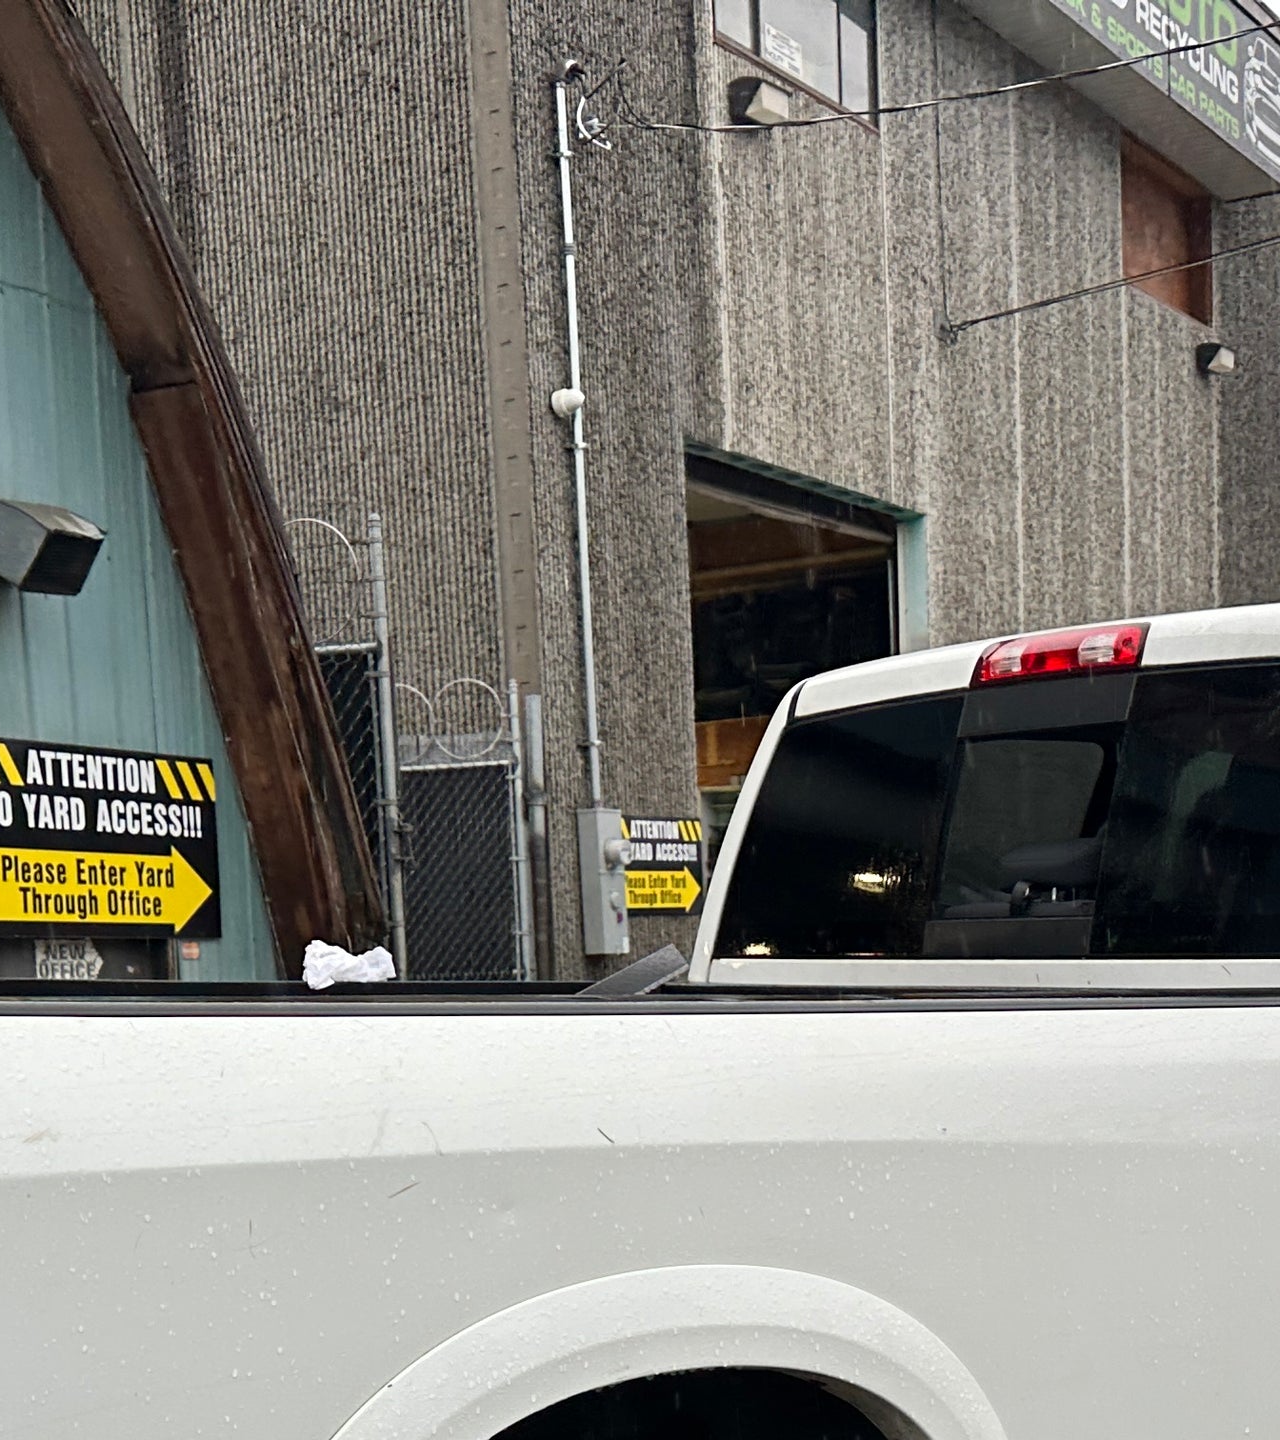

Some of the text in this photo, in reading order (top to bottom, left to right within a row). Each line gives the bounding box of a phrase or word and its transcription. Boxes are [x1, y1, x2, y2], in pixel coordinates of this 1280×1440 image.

[1136, 0, 1238, 104] RECYCLING
[1200, 91, 1240, 140] PARTS
[26, 749, 156, 795] ATTENTION
[21, 792, 87, 832] YARD
[96, 799, 203, 839] ACCESS!!!
[630, 820, 679, 839] ATTENTION
[1, 855, 174, 888] Please Enter Yard
[648, 874, 668, 889] Enter
[670, 874, 687, 889] Yard
[19, 887, 162, 919] Through Office
[629, 890, 682, 906] Through Office
[45, 943, 86, 960] NEW
[39, 960, 96, 978] OFFICE
